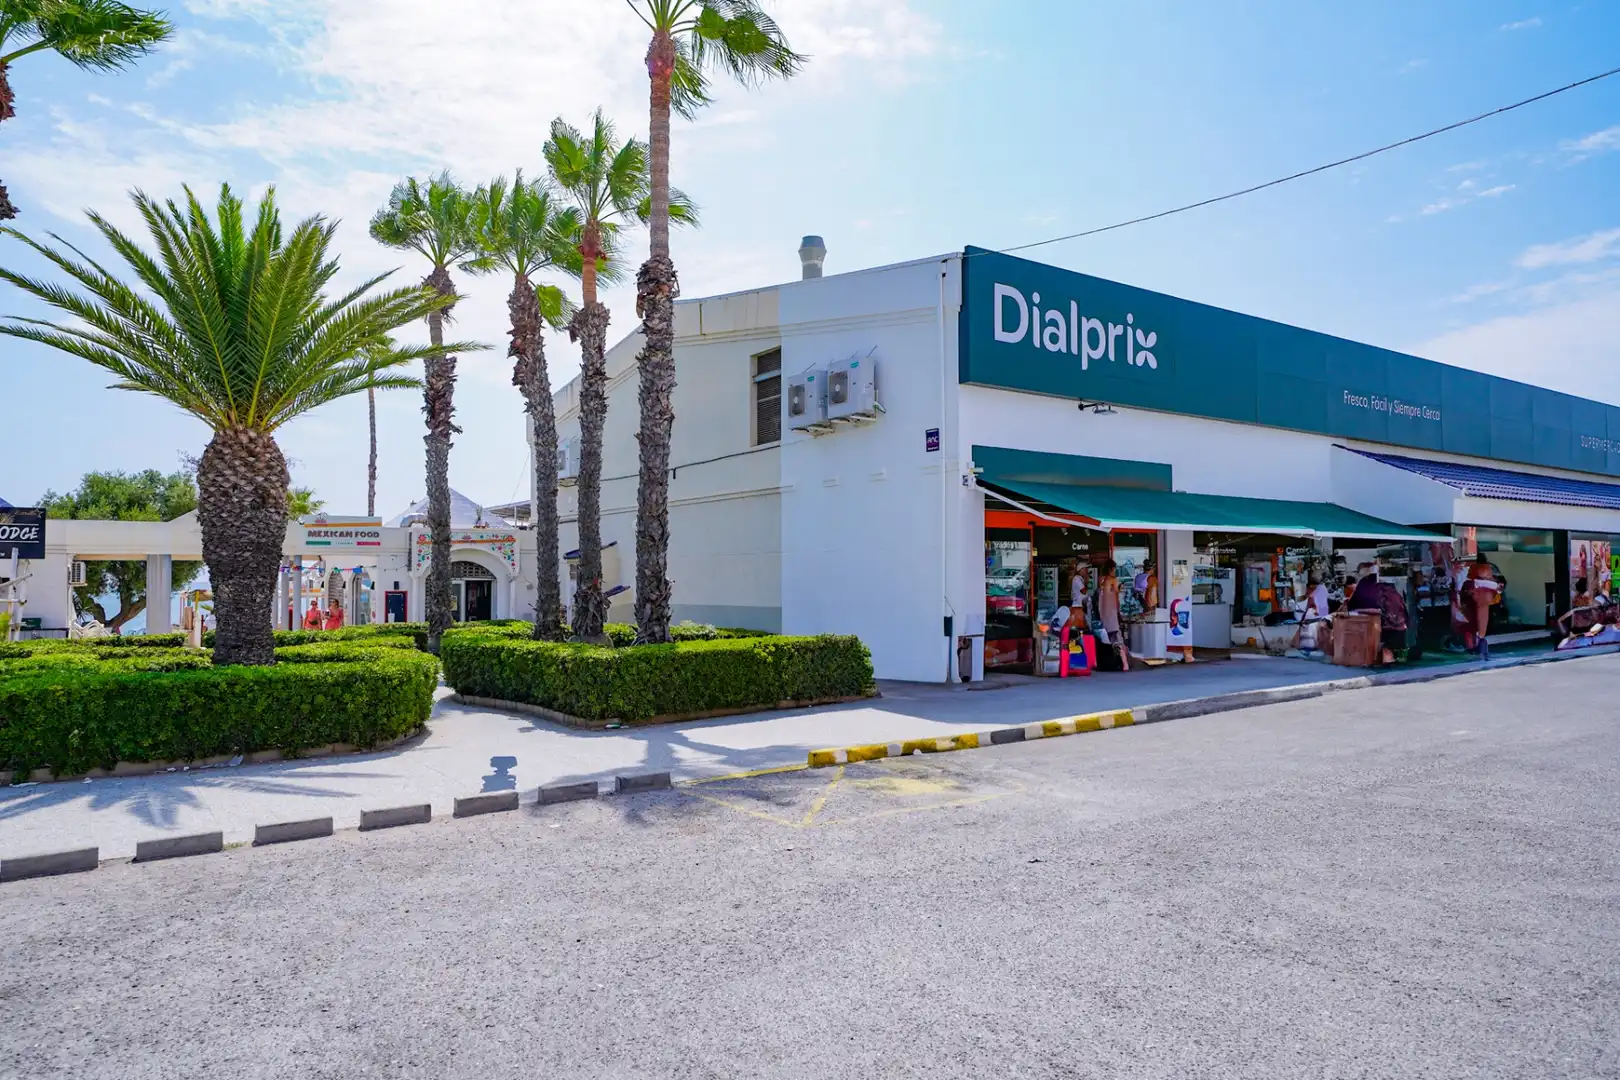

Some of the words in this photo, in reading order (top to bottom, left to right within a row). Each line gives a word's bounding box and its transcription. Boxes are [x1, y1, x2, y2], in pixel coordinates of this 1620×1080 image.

[993, 282, 1158, 371] Dialprix
[1343, 390, 1370, 410] Fresco,
[1388, 402, 1393, 416] y
[1393, 399, 1421, 419] Siempre
[307, 530, 353, 538] MEXICAN
